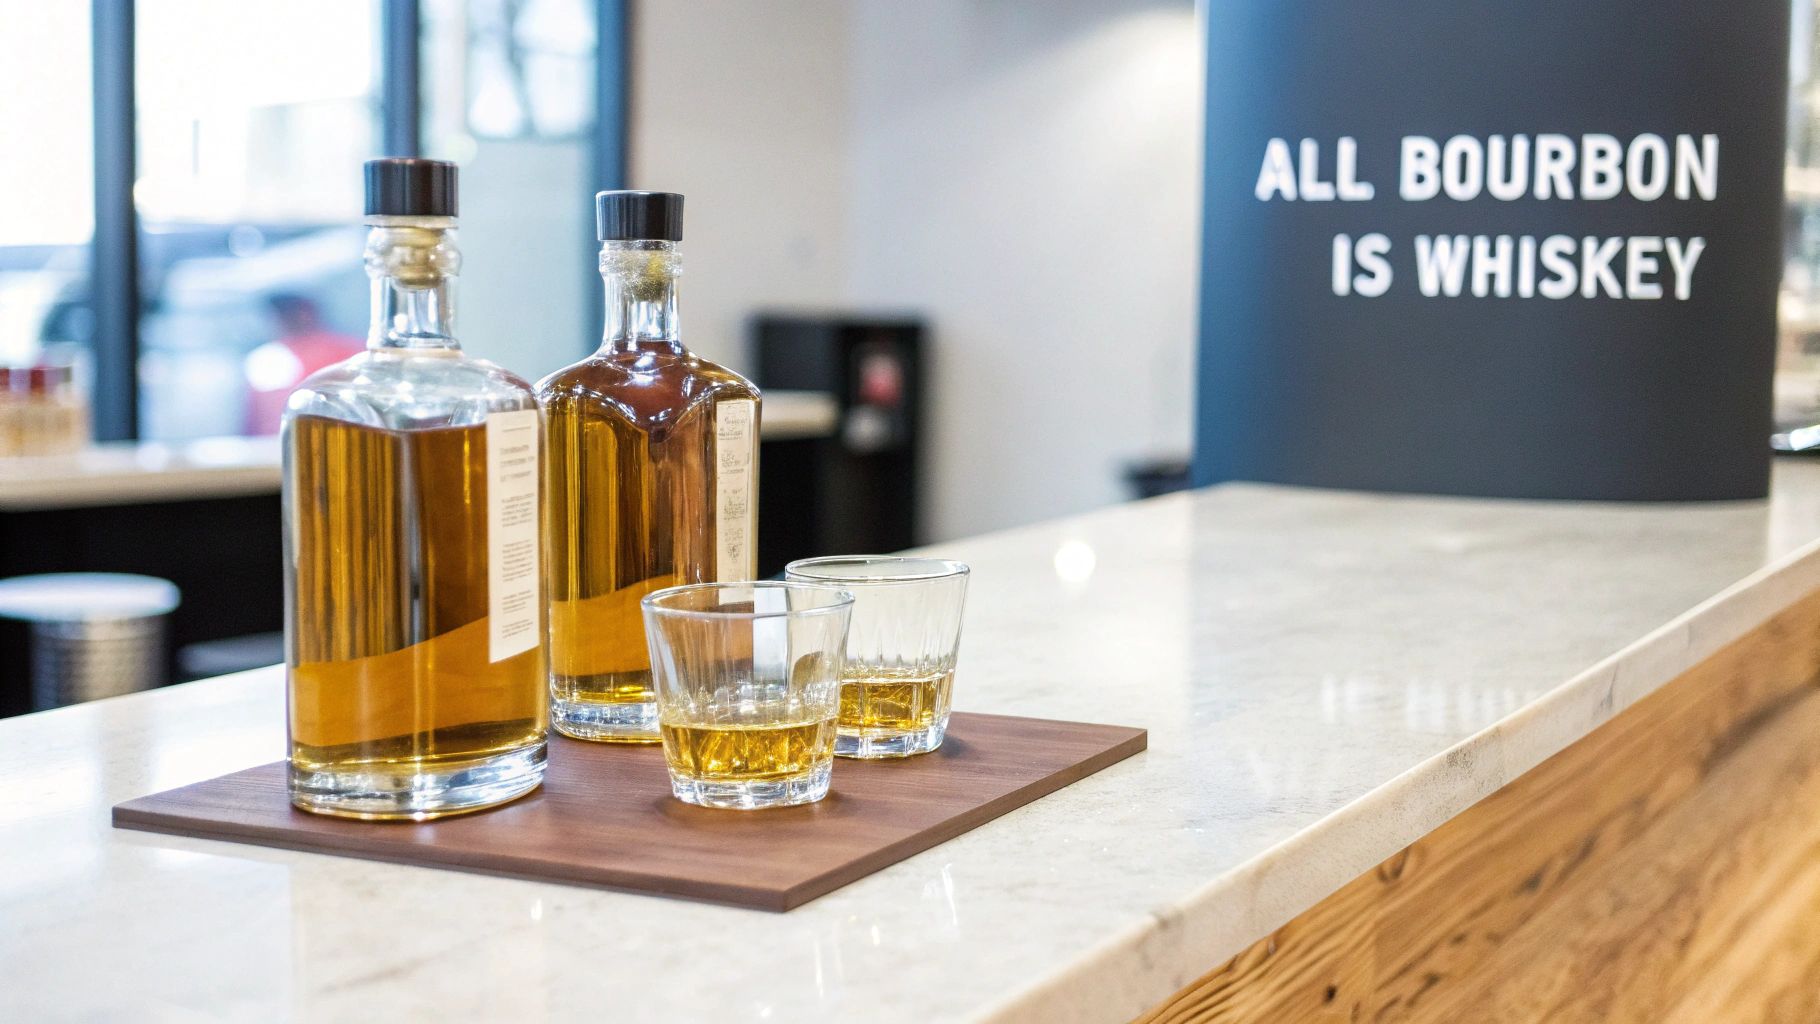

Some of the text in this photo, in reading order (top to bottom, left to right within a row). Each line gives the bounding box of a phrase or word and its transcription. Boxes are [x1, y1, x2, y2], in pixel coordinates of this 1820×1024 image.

[1255, 133, 1719, 202] ALL BOURBON
[1331, 233, 1706, 301] IS WHISKEY
